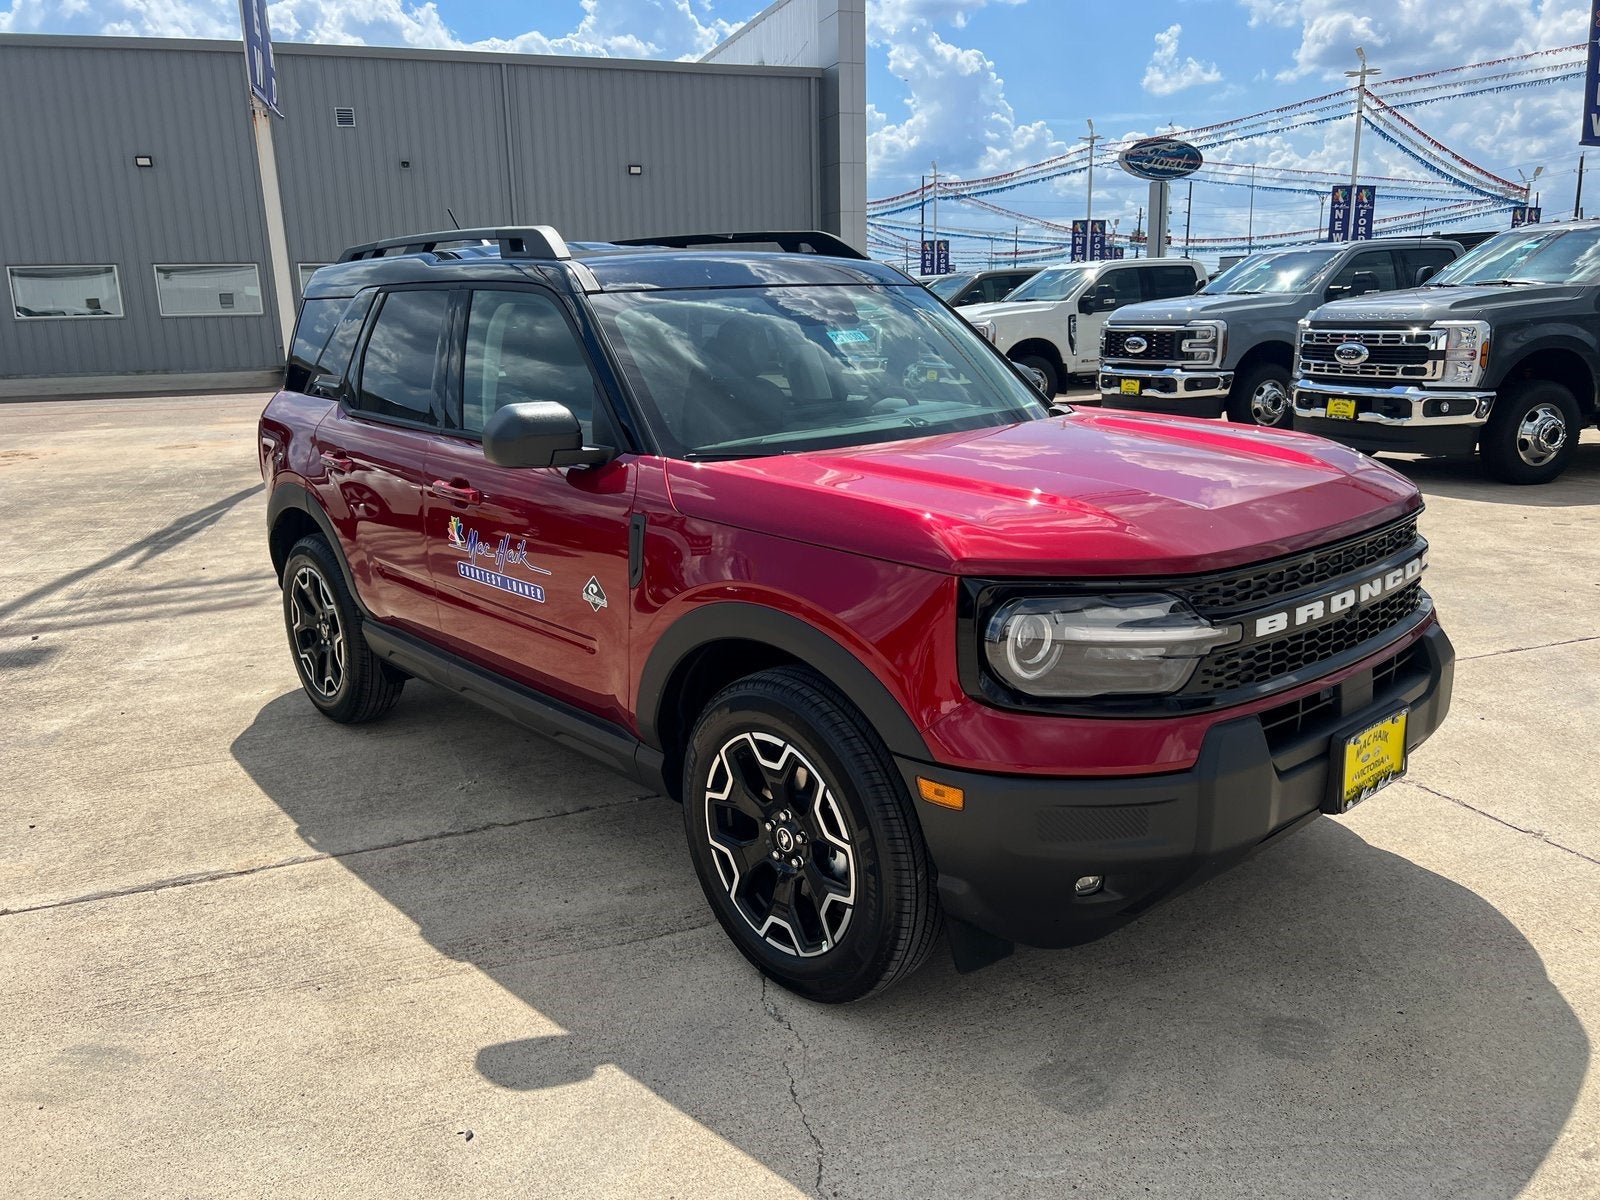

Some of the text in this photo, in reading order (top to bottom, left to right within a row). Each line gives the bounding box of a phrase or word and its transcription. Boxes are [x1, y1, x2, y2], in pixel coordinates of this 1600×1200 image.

[1332, 209, 1344, 242] NEW
[1357, 209, 1368, 240] FORD
[1074, 237, 1083, 261] NEW
[462, 527, 546, 574] Mac Haik
[459, 563, 543, 601] COURTESY LOANER
[1255, 557, 1421, 638] BRONCO
